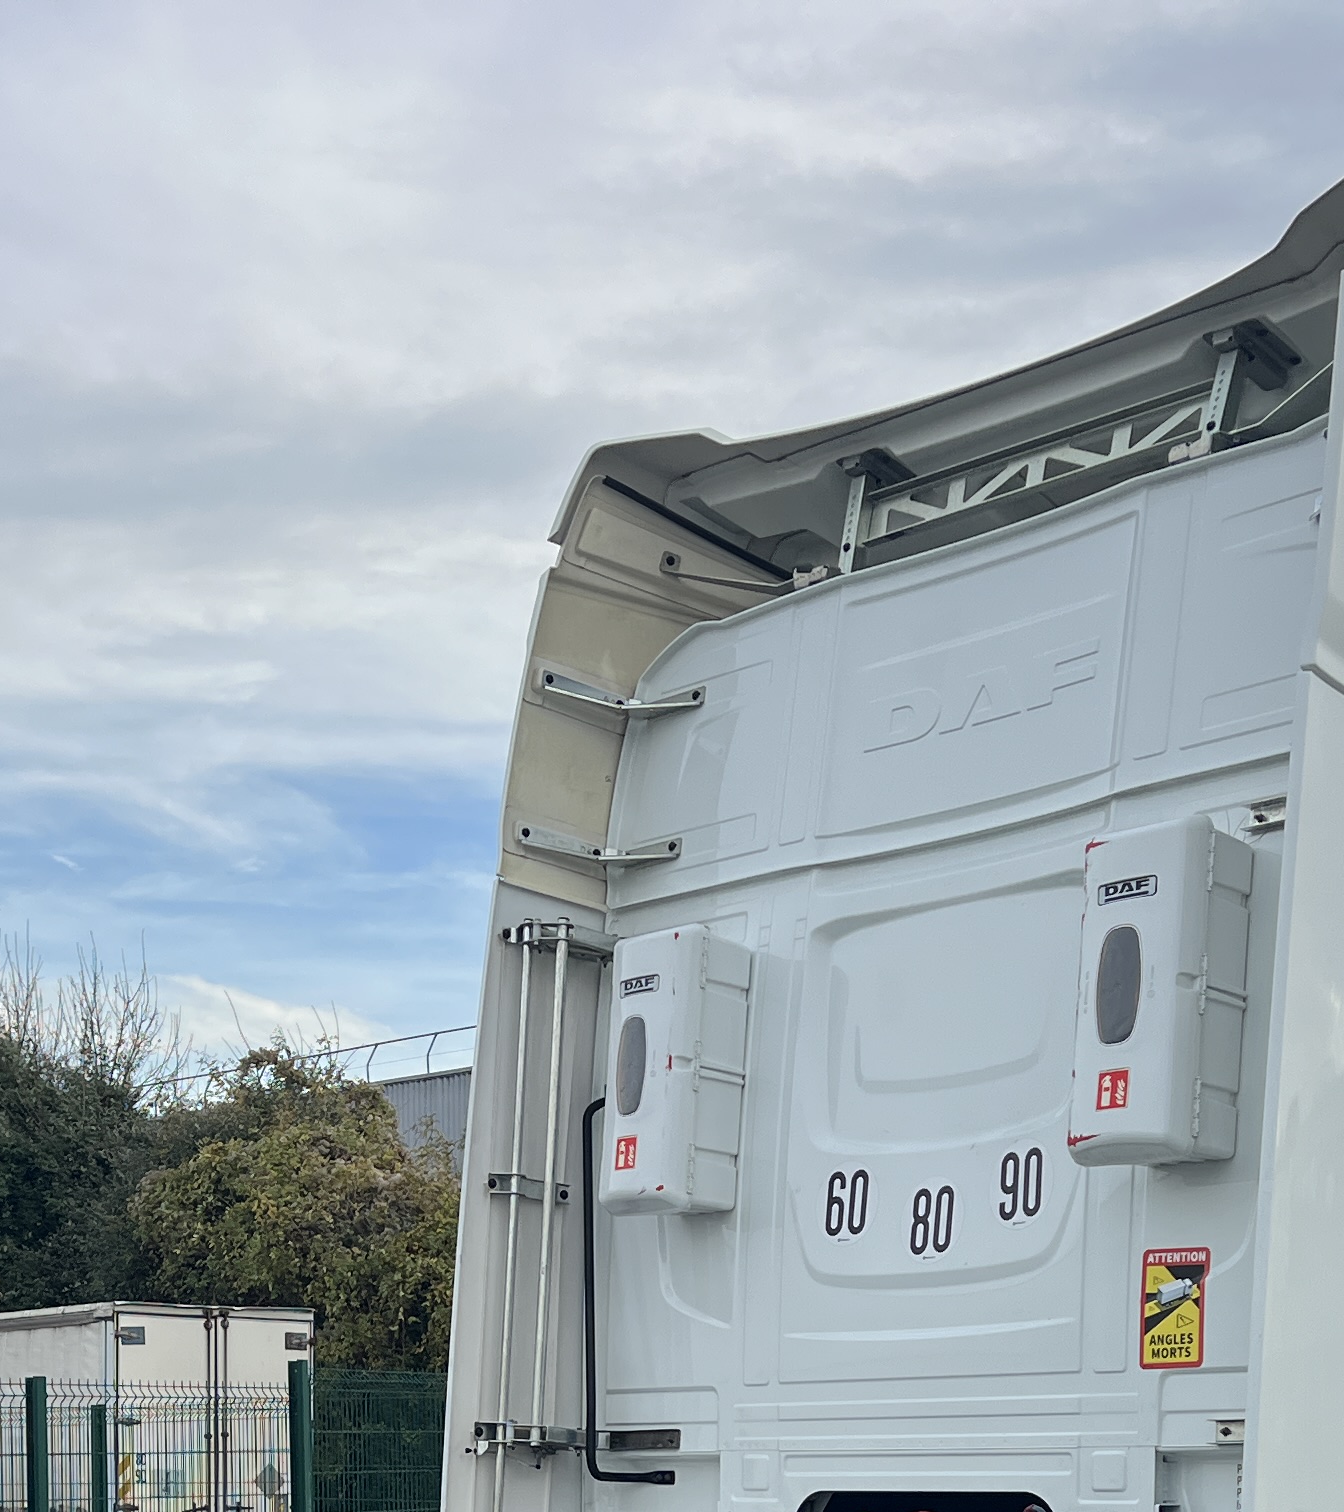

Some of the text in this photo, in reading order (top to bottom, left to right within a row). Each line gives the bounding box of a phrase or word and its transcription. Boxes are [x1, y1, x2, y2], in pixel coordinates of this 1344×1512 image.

[862, 635, 1101, 753] DAF
[1104, 878, 1150, 897] DAF
[624, 976, 655, 991] DAF
[998, 1147, 1043, 1221] 90
[825, 1169, 869, 1236] 60
[910, 1185, 954, 1255] 80
[1146, 1251, 1207, 1264] ATTENTION
[1148, 1332, 1194, 1347] ANGLES
[1151, 1346, 1192, 1360] MORTS
